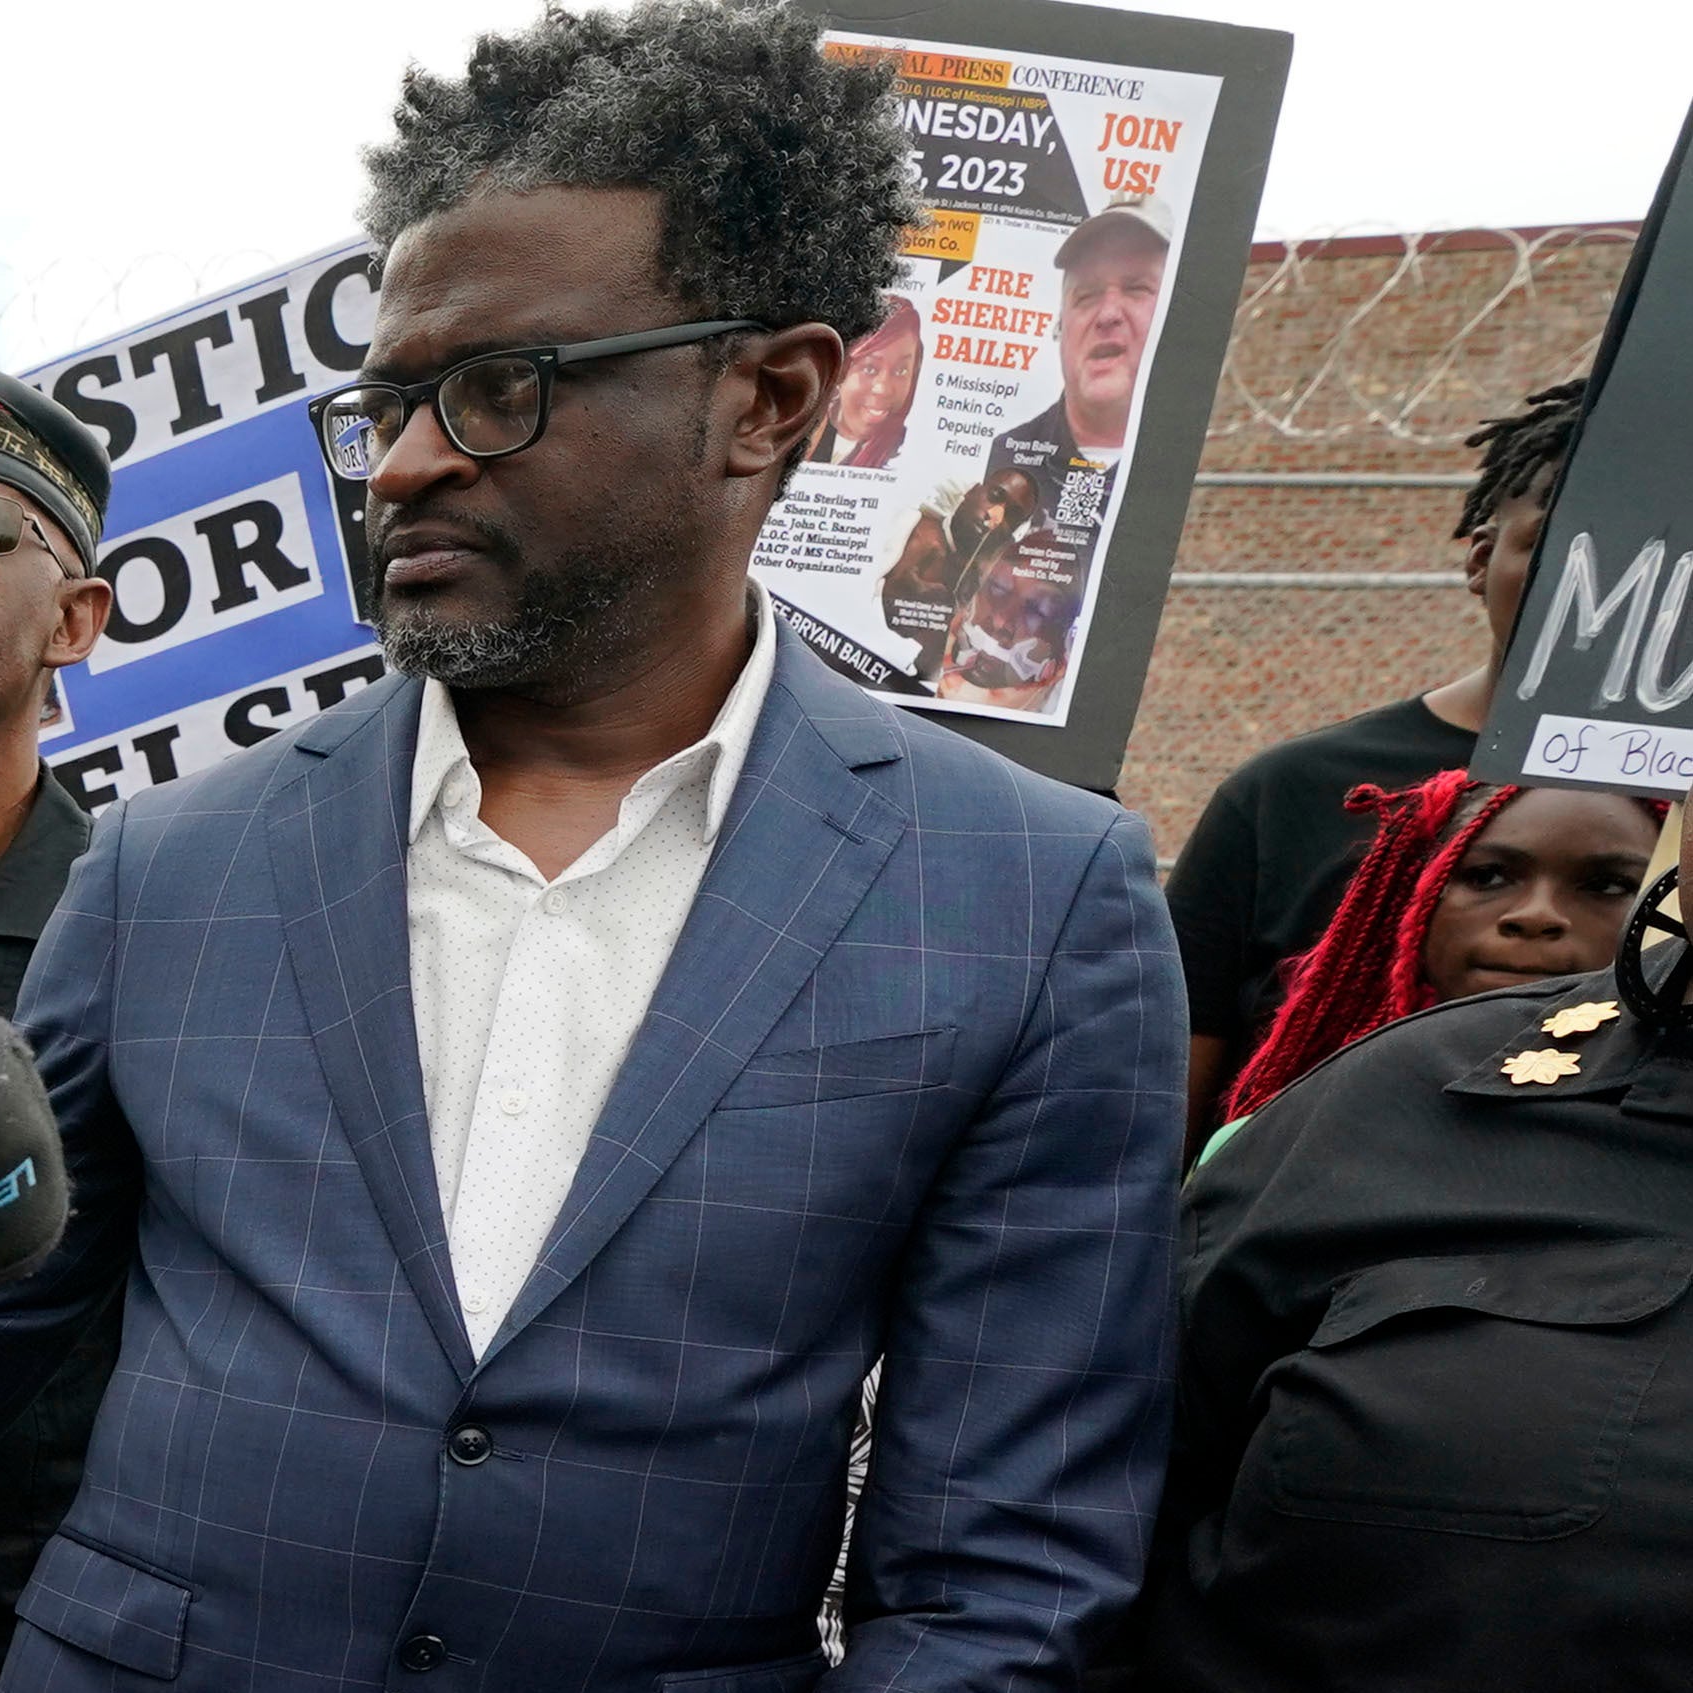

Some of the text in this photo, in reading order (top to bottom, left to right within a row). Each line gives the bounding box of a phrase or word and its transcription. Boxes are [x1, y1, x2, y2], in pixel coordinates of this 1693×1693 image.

[941, 57, 1004, 83] PRESS
[1013, 65, 1144, 100] CONFERENCE
[1098, 113, 1183, 153] JOIN
[936, 154, 1028, 196] 2023
[1103, 157, 1162, 195] US!
[939, 237, 960, 251] Co.
[968, 266, 1034, 298] FIRE
[931, 297, 1053, 338] SHERIFF
[34, 252, 382, 464] STIC
[933, 334, 1038, 371] BAILEY
[935, 373, 1020, 398] 6 Mississippi
[937, 396, 1005, 418] Rankin Co.
[937, 417, 994, 438] Deputies
[945, 440, 981, 458] Fired!
[1006, 437, 1059, 456] Bryan Bailey
[1013, 453, 1045, 466] Sheriff
[813, 493, 857, 509] Sterling
[860, 497, 879, 509] Till
[829, 508, 856, 520] Potts
[790, 518, 815, 530] John
[818, 521, 828, 531] C.
[831, 522, 871, 535] Barnett
[793, 532, 805, 542] of
[806, 533, 868, 550] Mississippi
[791, 545, 802, 555] of
[804, 547, 823, 558] MS
[826, 549, 873, 563] Chapters
[785, 558, 862, 576] Organizations
[789, 614, 842, 655] BRYAN
[838, 642, 893, 685] BAILEY
